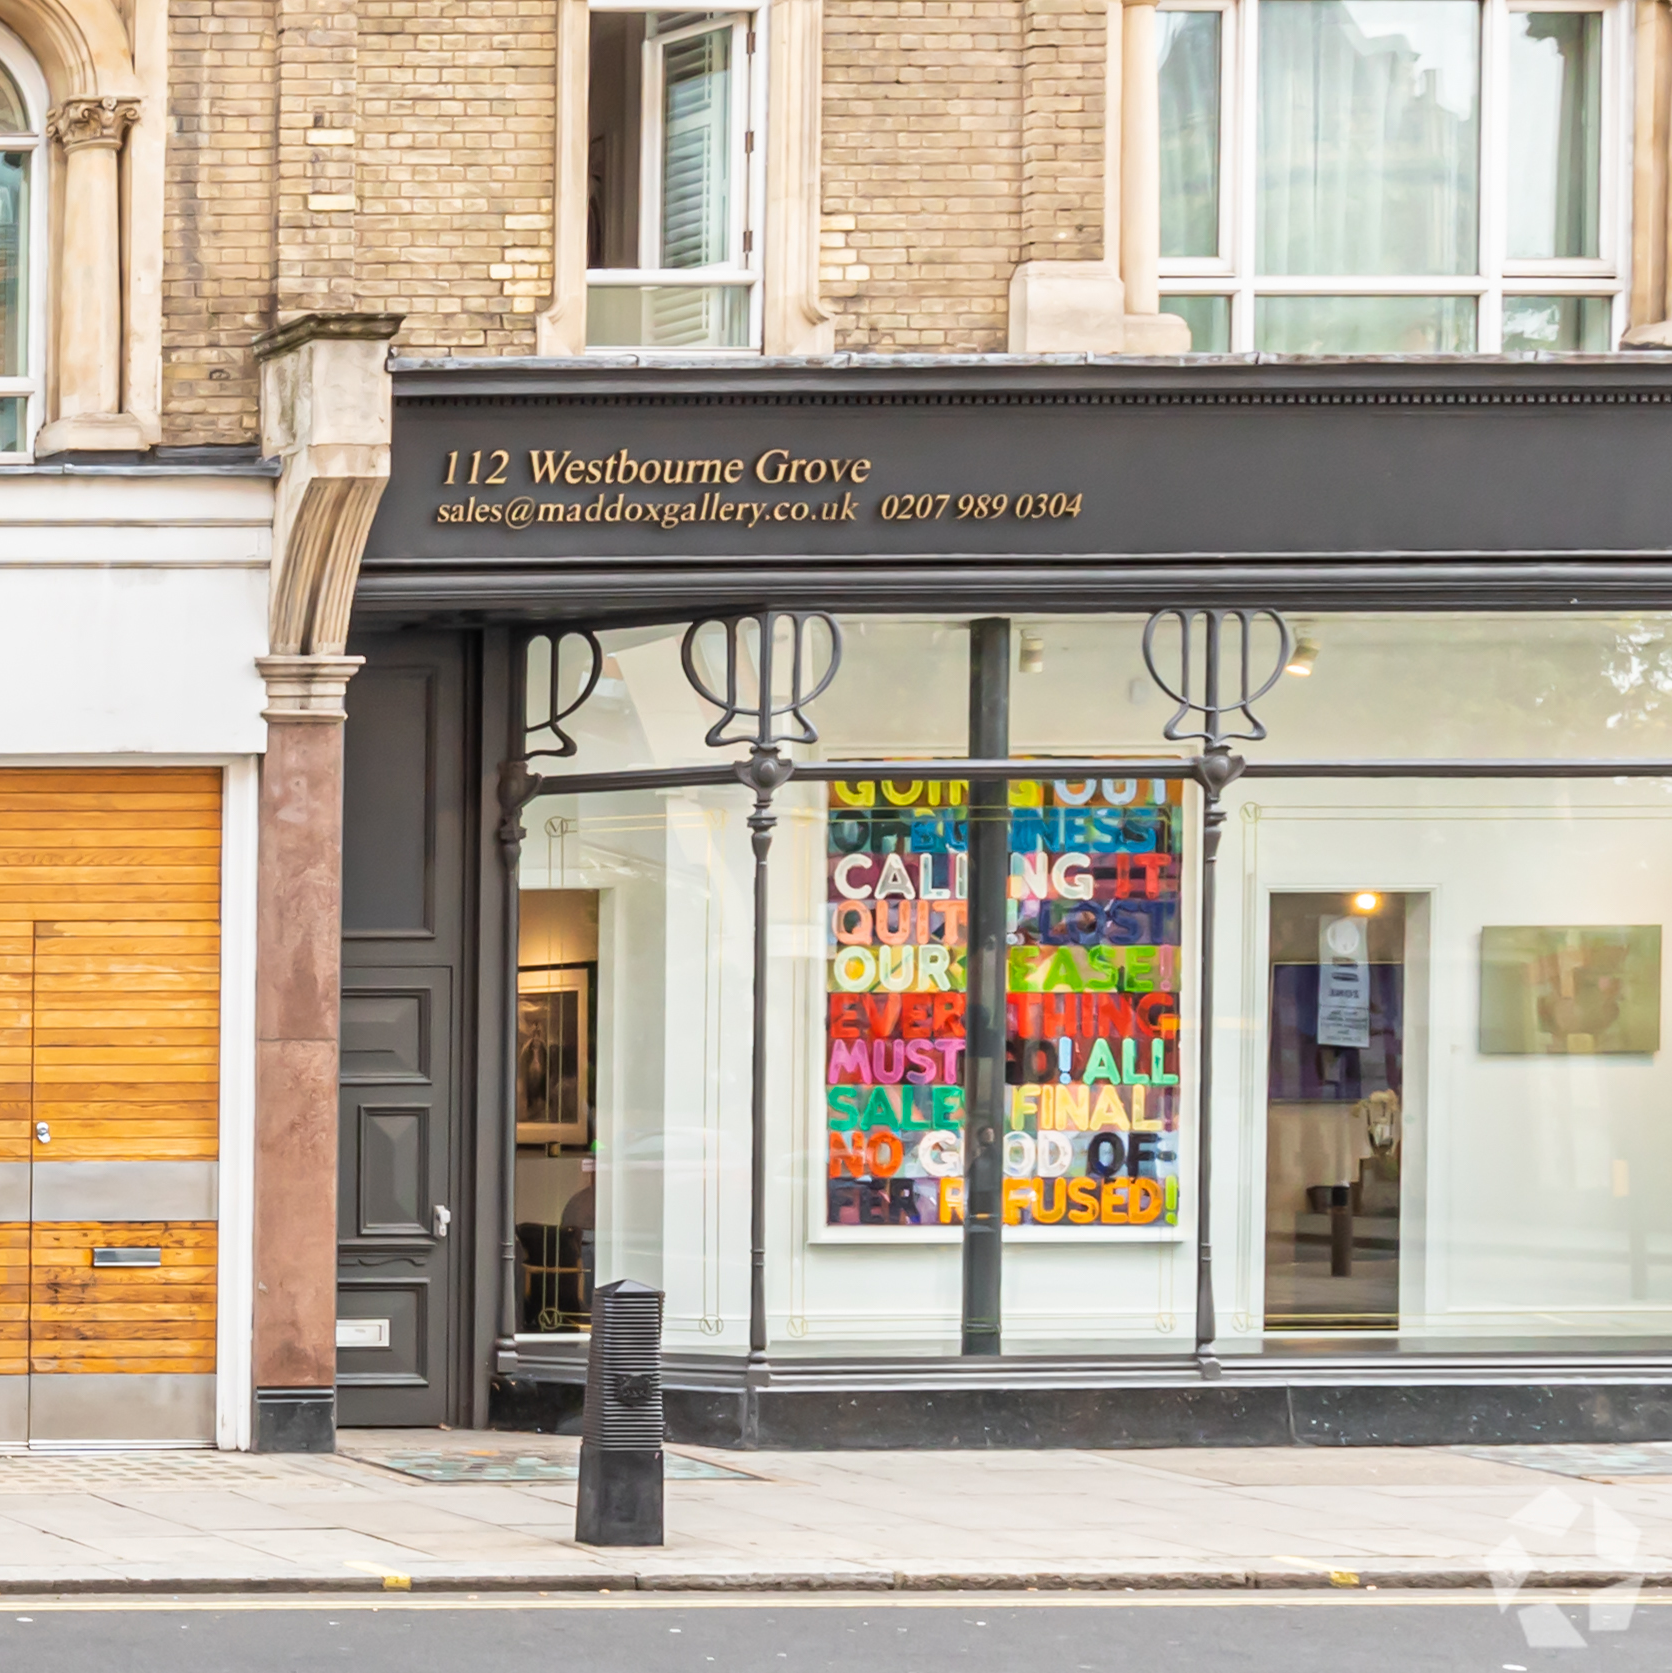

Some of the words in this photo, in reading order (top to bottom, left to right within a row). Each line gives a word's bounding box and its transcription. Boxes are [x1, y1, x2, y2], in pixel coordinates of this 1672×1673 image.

[443, 449, 511, 485] 112
[529, 447, 744, 485] Westbourne
[755, 448, 872, 484] Grove
[437, 491, 859, 529] sales@maddoxgallery.co.uk
[881, 493, 950, 520] 0207
[954, 493, 1008, 519] 989
[1014, 492, 1083, 519] 0304
[834, 779, 1040, 807] GOIG
[911, 808, 1157, 853] BUNESS
[834, 852, 1095, 900] CALNG
[1115, 852, 1172, 899] IT
[832, 899, 1025, 946] QUIT!
[1041, 898, 1166, 945] LOST
[833, 943, 952, 992] OUR
[1007, 943, 1174, 992] EASE!
[830, 992, 1179, 1039] EVERTHING
[828, 1038, 967, 1085] MUST
[1082, 1037, 1180, 1085] ALL
[827, 1084, 965, 1131] SALE
[1011, 1084, 1173, 1132] FINAL!
[829, 1131, 904, 1178] NO
[918, 1130, 1073, 1178] GOD
[938, 1175, 1178, 1226] RFUSED!
